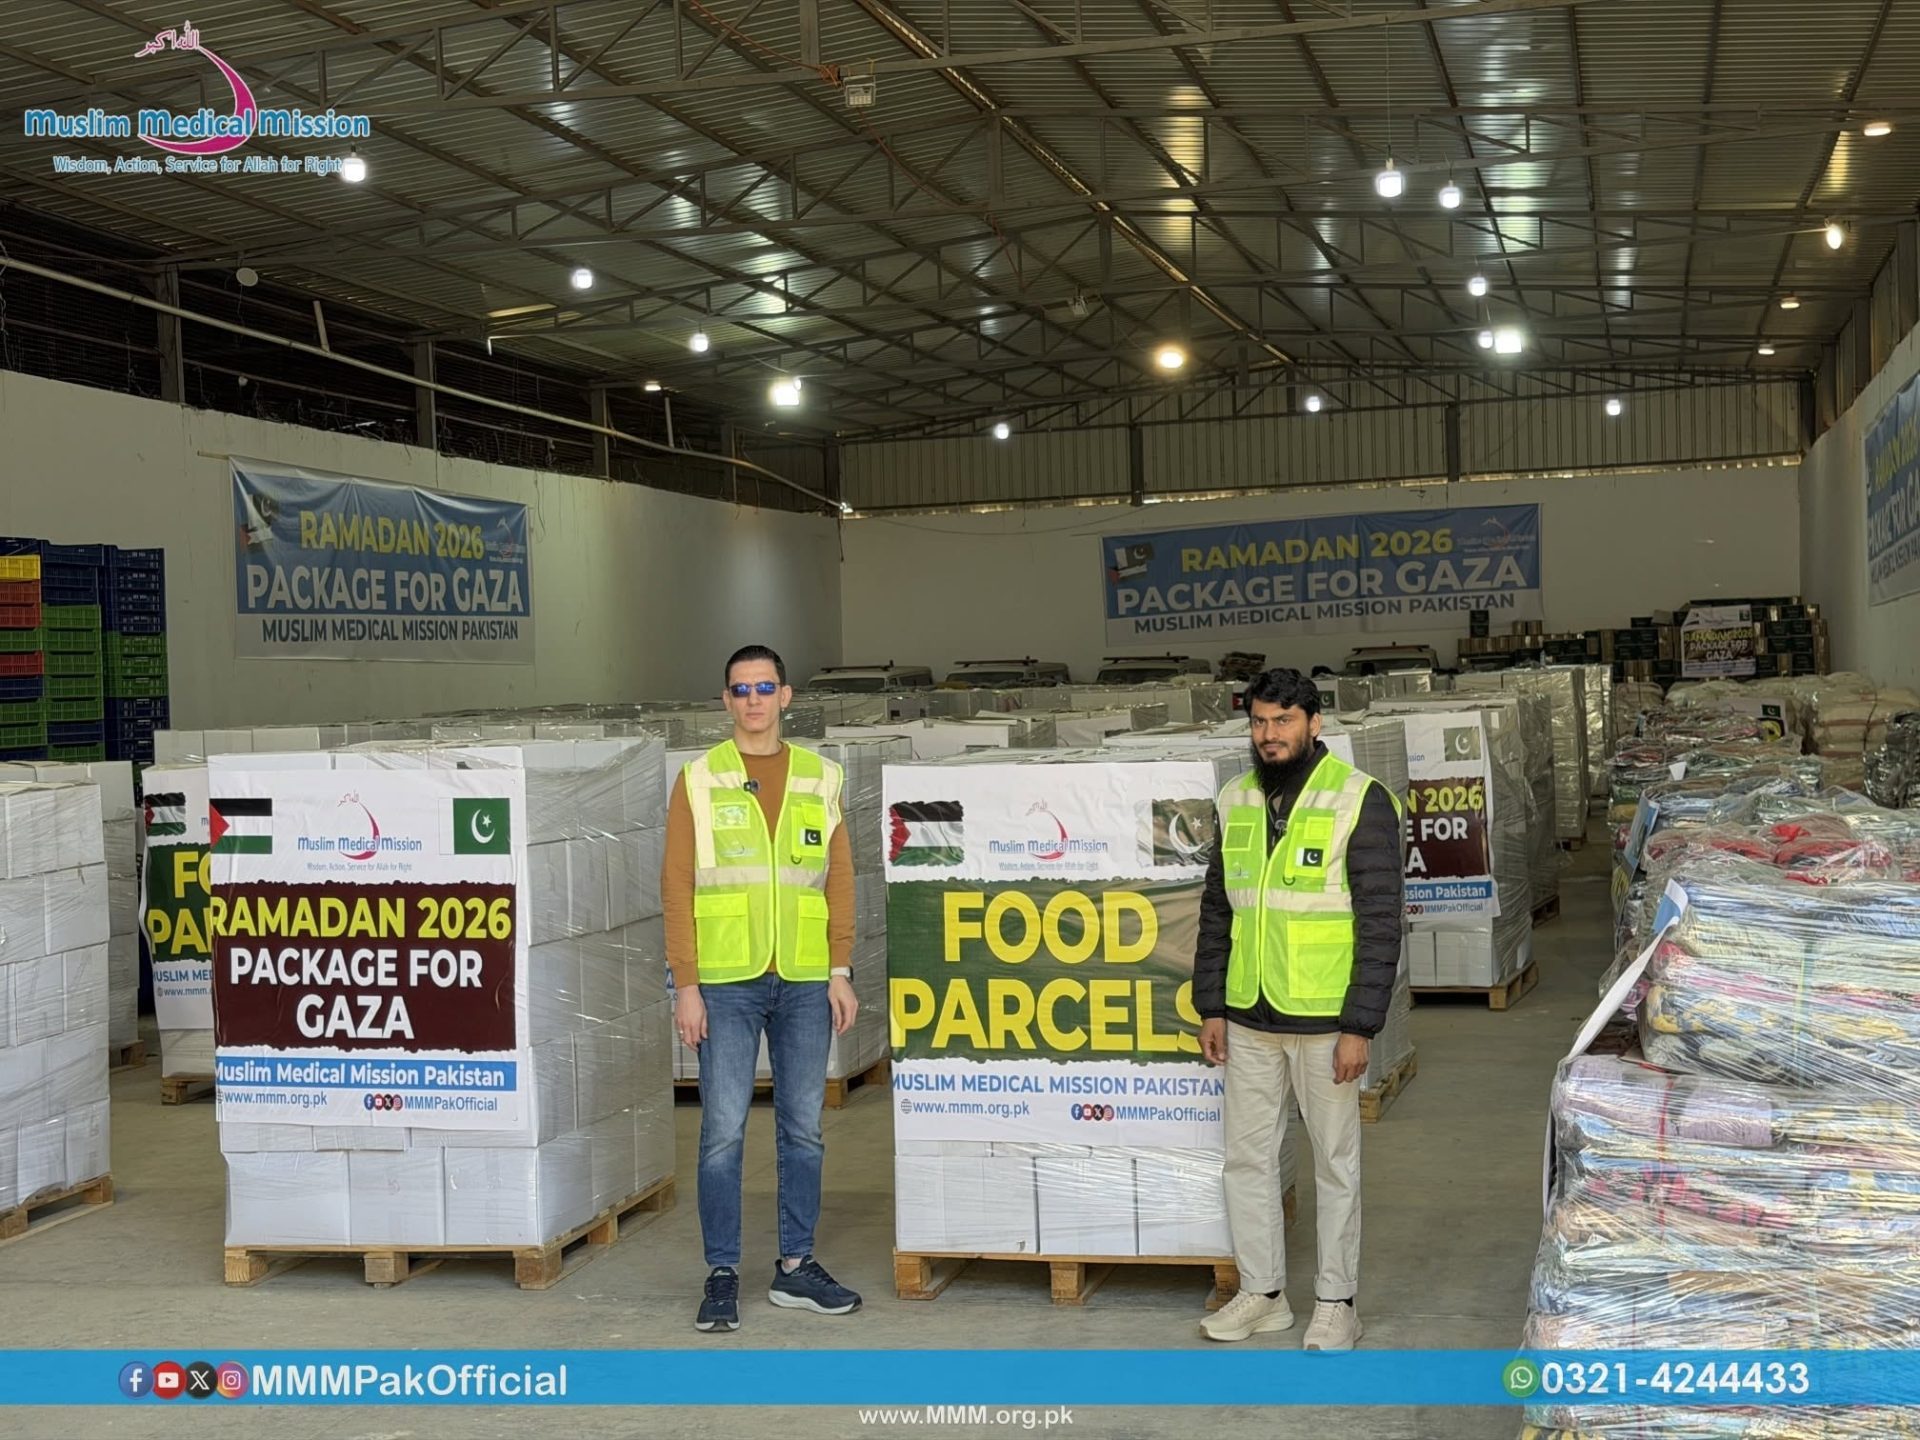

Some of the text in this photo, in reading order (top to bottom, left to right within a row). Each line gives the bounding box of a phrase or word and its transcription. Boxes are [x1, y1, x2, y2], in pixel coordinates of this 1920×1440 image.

[299, 510, 484, 560] RAMADAN 2026
[1181, 528, 1453, 573] RAMADAN 2026
[246, 565, 523, 613] PACKAGE FOR GAZA
[1117, 555, 1527, 615] PACKAGE FOR GAZA
[262, 619, 518, 642] MUSLIM MEDICAL MISSION PAKISTAN
[1134, 593, 1515, 634] MUSLIM MEDICAL MISSION PAKISTAN
[1706, 650, 1734, 660] GAZA
[1425, 785, 1483, 812] 2026
[1421, 817, 1468, 841] FOR
[1405, 884, 1486, 899] ssion Pakistan
[211, 897, 405, 938] RAMADAN
[417, 897, 512, 940] 2026
[943, 890, 1158, 964] FOOD
[230, 947, 482, 988] PACKAGE FOR
[296, 994, 415, 1039] GAZA
[277, 1062, 345, 1084] Medical
[351, 1063, 418, 1085] Mission
[425, 1063, 504, 1086] Pakistan
[962, 1075, 1044, 1092] MEDICAL
[1050, 1076, 1126, 1094] MISSION
[1134, 1078, 1224, 1095] PAKISTAN
[224, 1091, 497, 1111] www.mmm.org.pk MMMPakOfficial
[913, 1101, 1220, 1121] www.mmm.org.pk MMMPakOfficial
